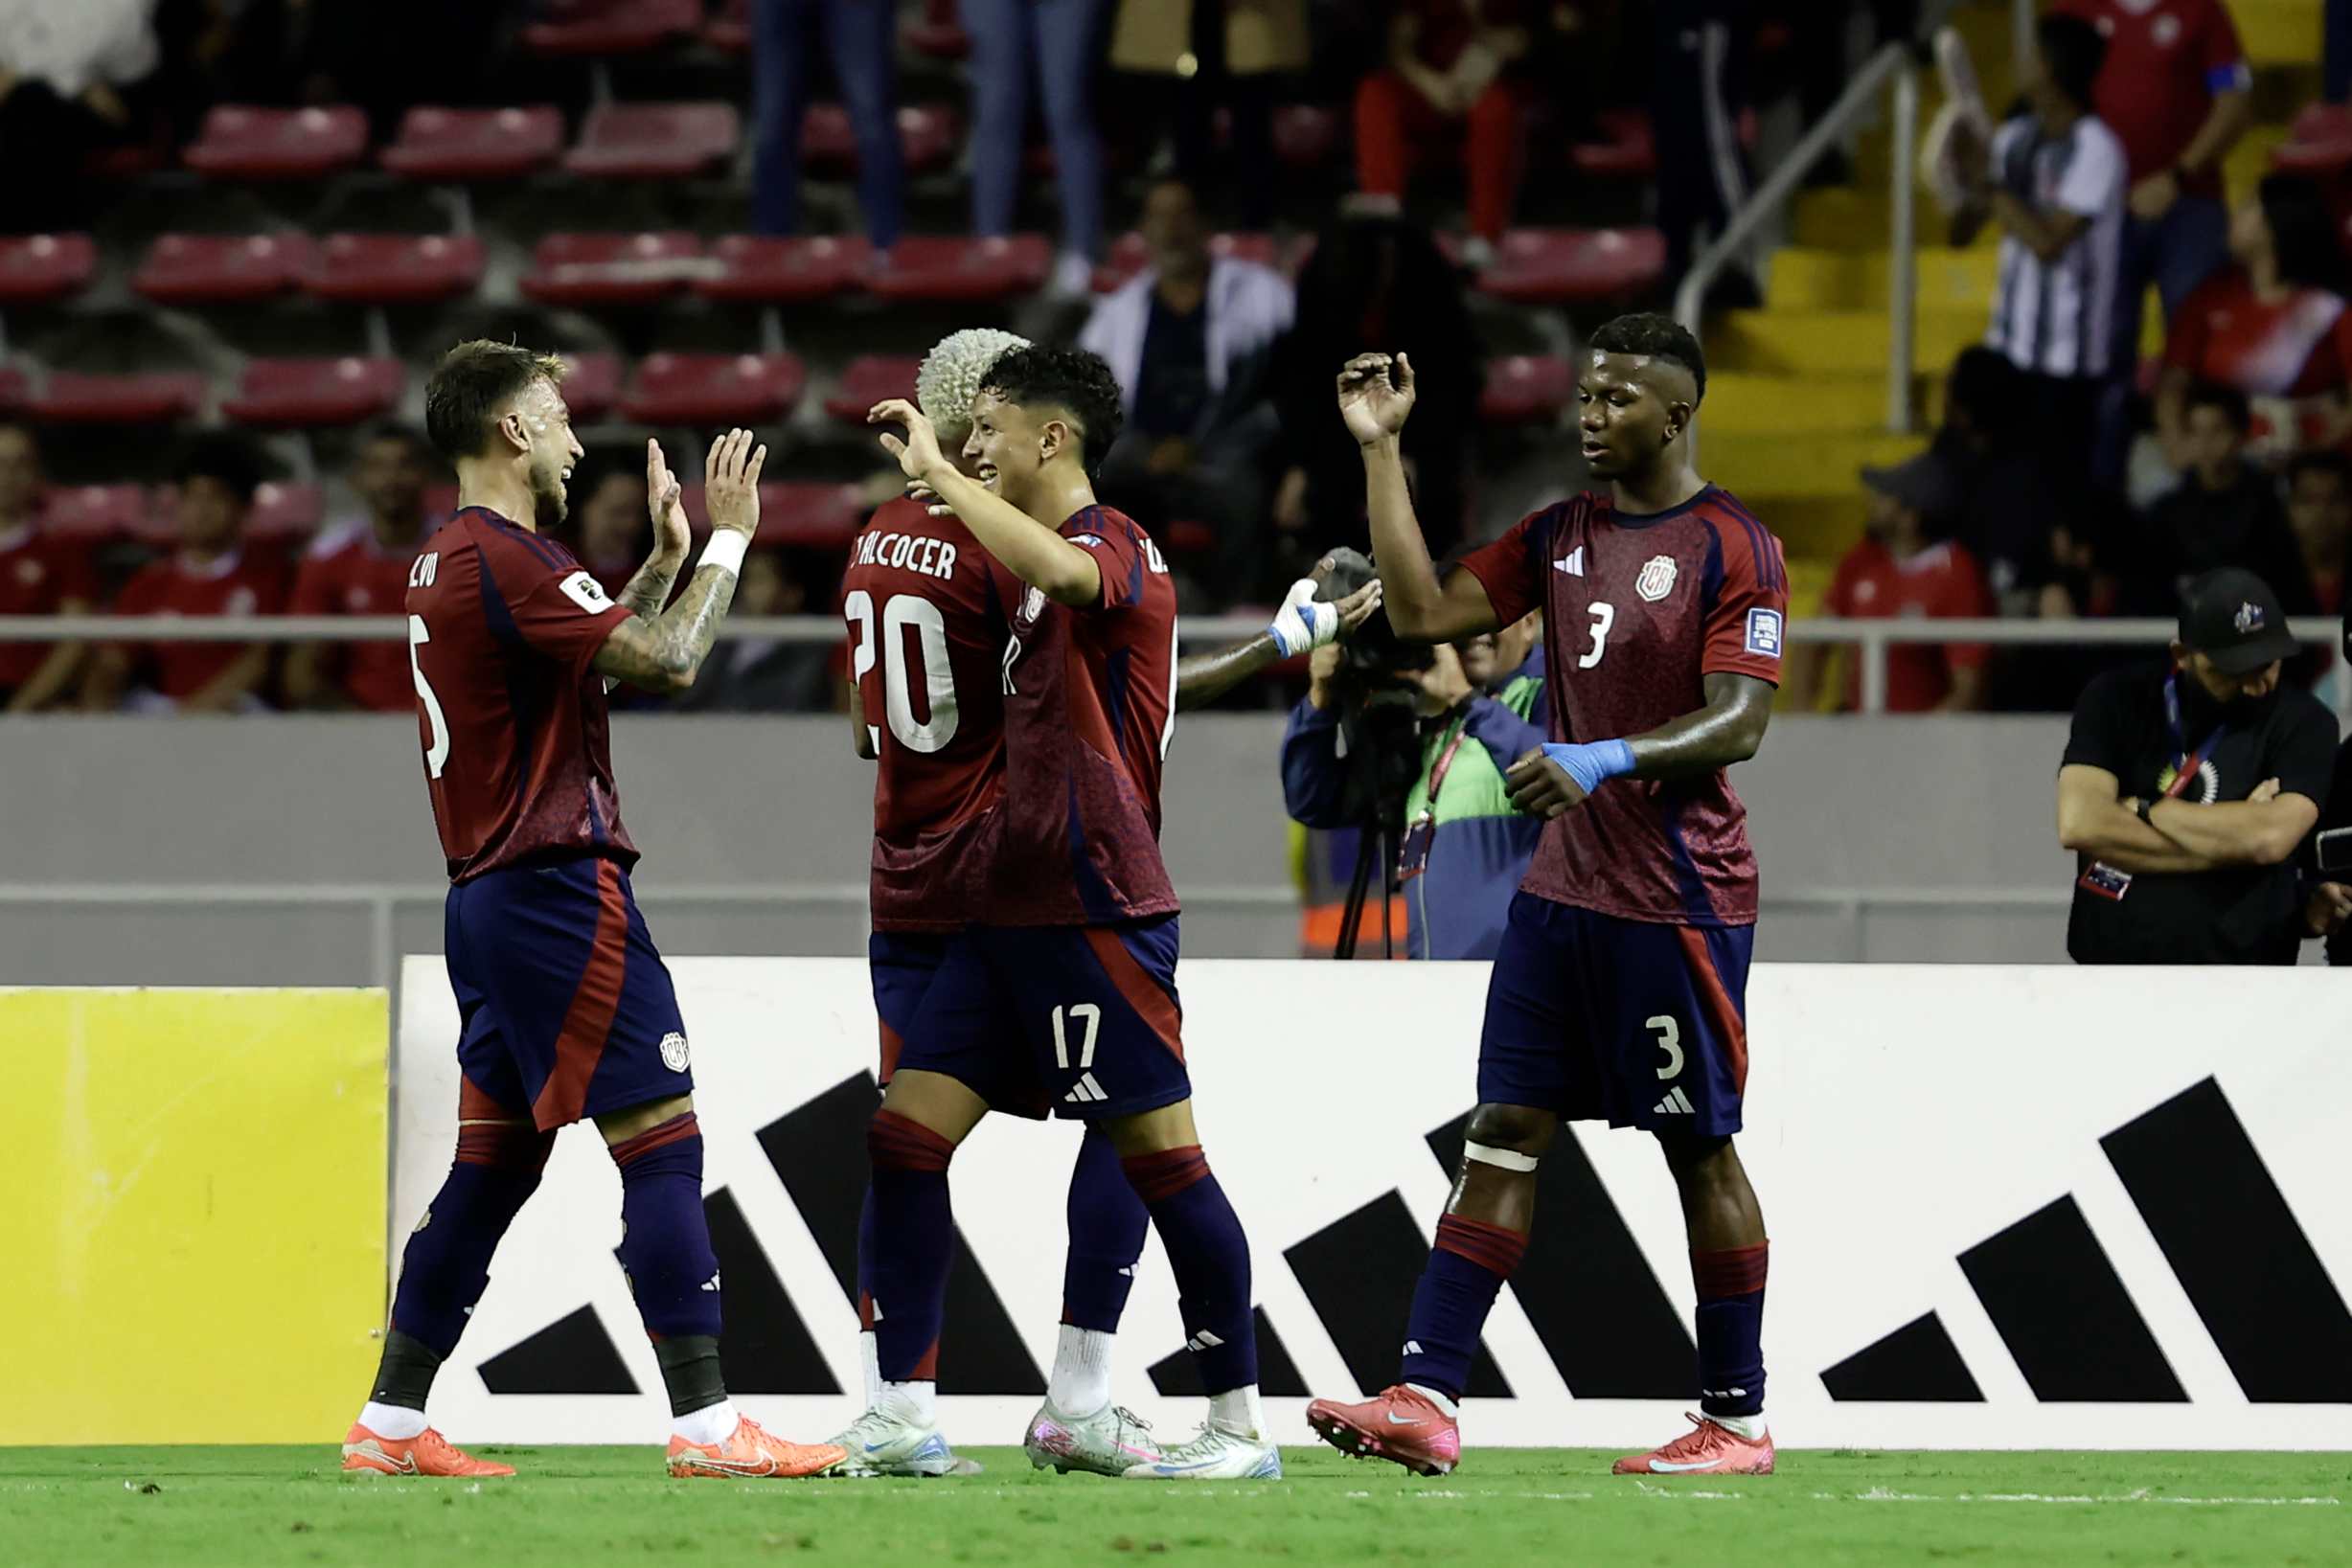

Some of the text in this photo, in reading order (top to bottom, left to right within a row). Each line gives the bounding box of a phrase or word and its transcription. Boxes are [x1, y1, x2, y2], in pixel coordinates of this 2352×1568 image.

[1577, 601, 1615, 669] 3
[1051, 1002, 1102, 1069] 17
[1645, 1014, 1685, 1080] 3
